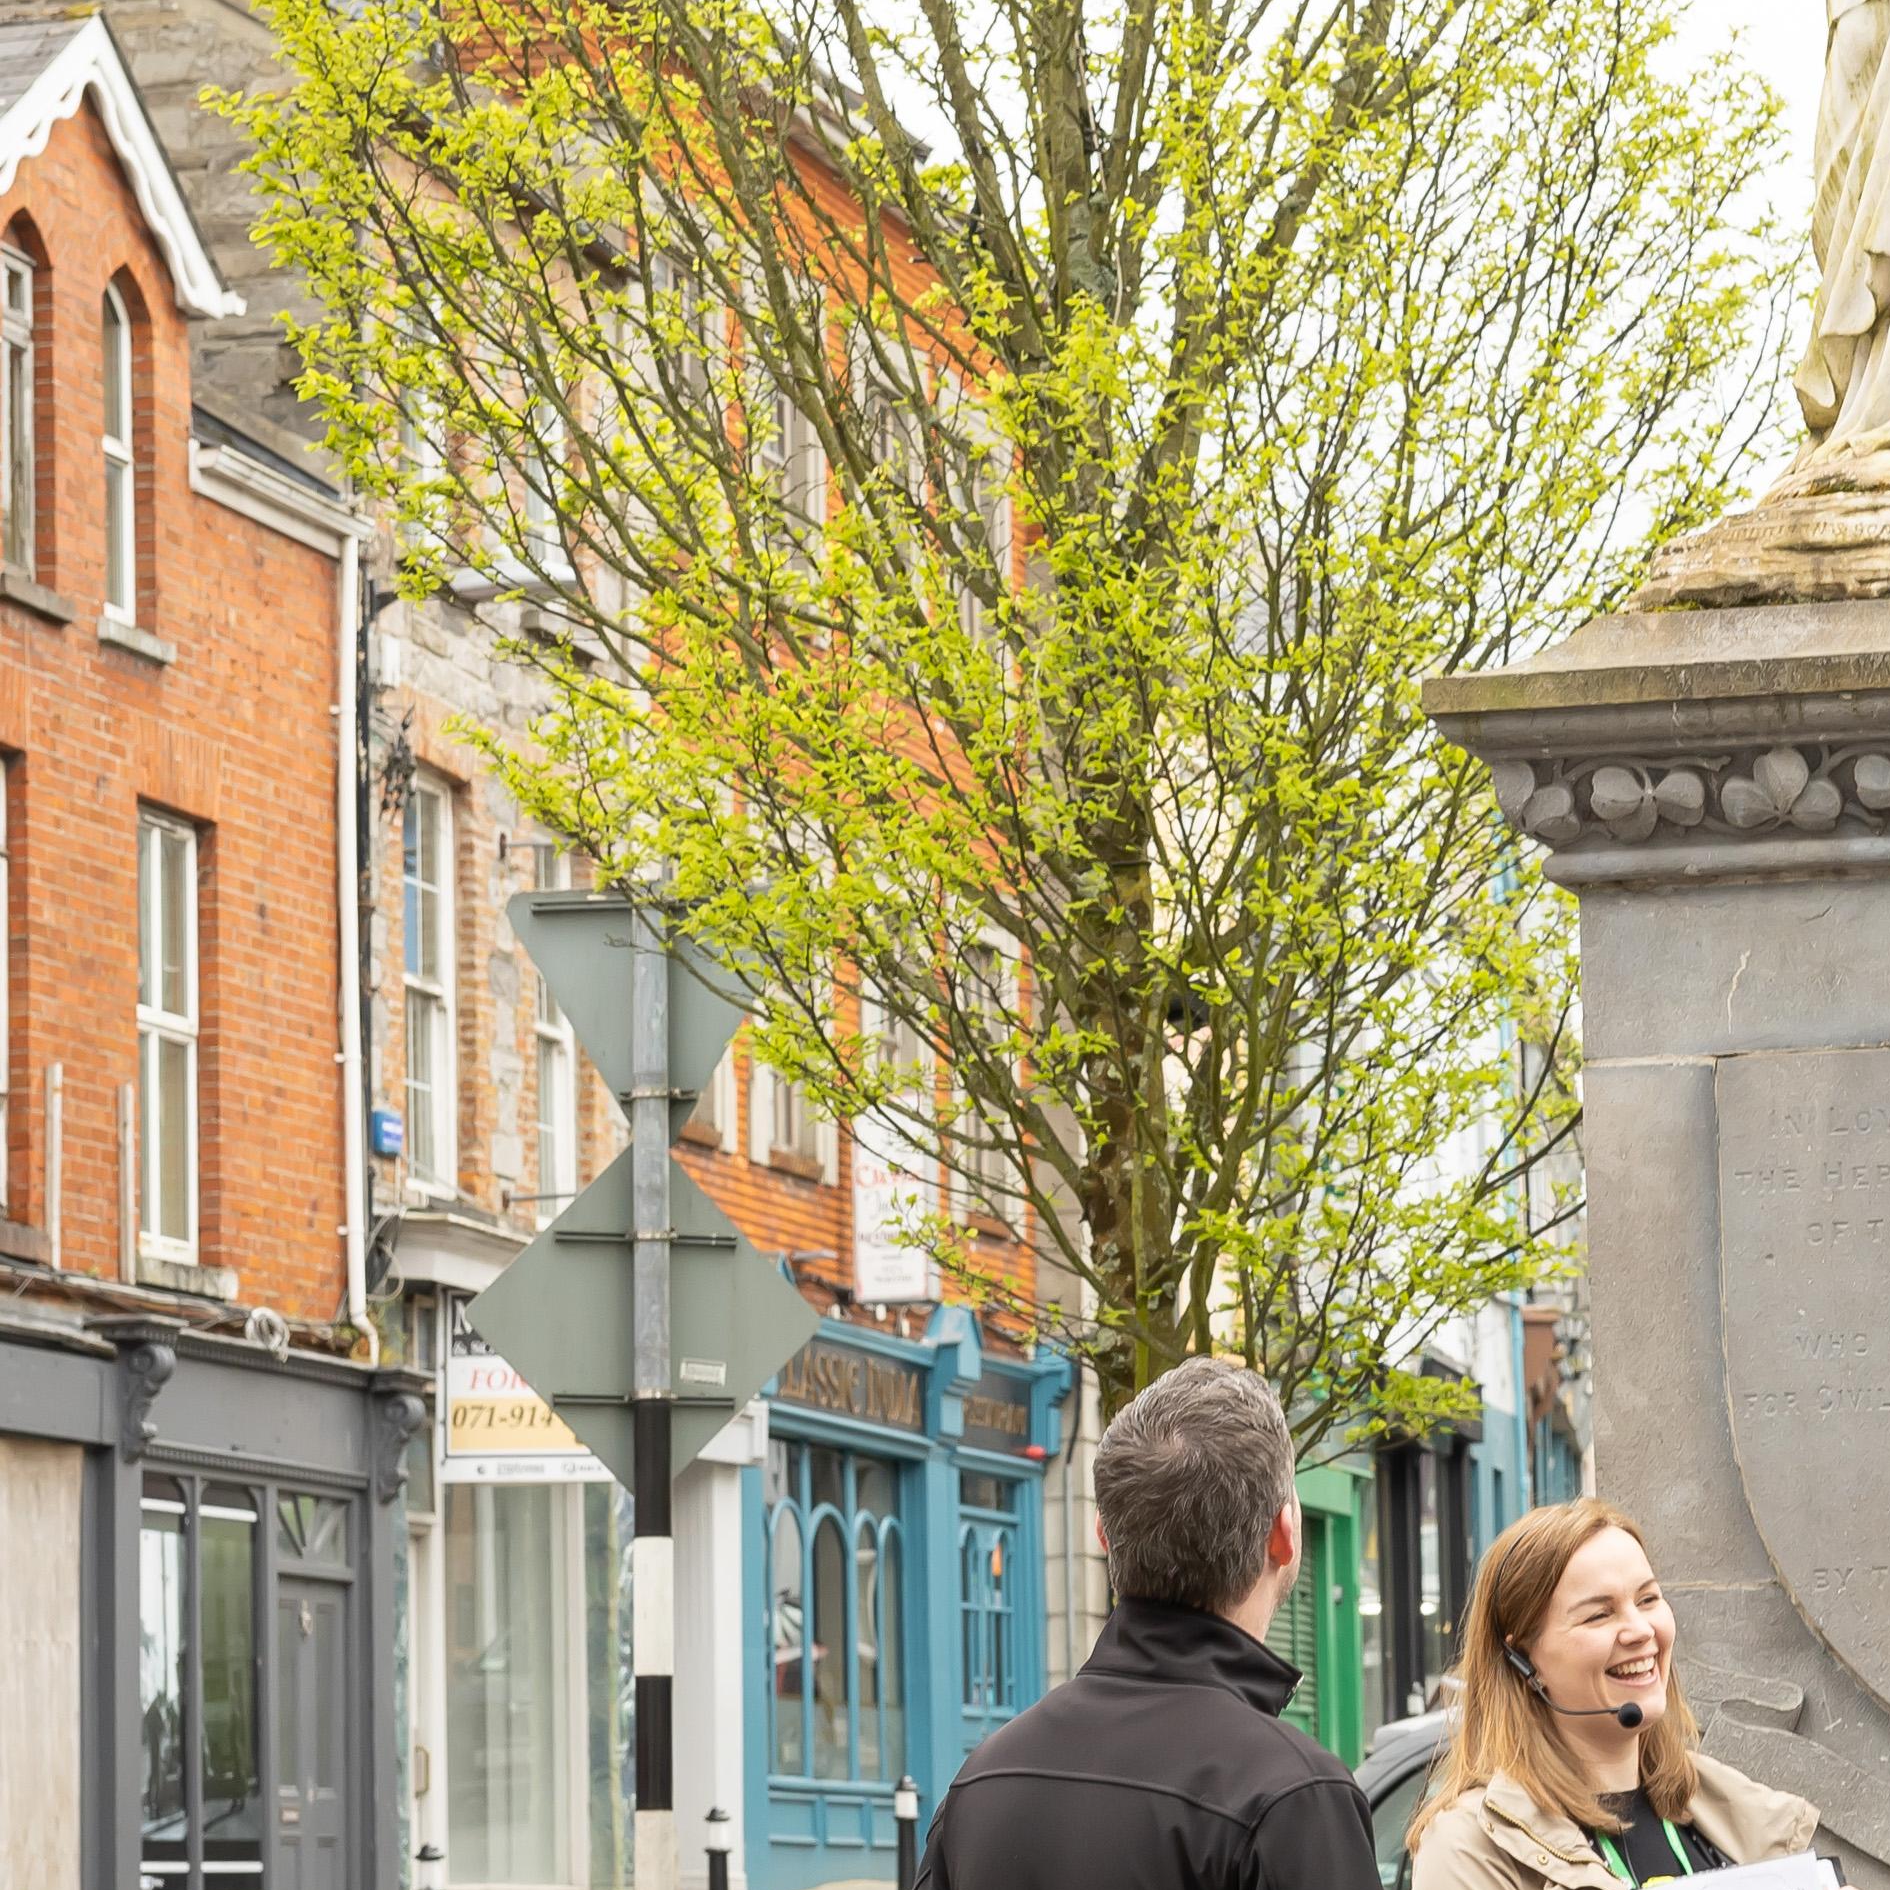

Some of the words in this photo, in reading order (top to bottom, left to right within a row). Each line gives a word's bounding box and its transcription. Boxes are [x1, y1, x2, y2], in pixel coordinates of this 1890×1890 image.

[1734, 1166, 1803, 1197] THE
[1806, 1219, 1851, 1247] OF
[1794, 1331, 1871, 1360] WHO
[779, 1342, 861, 1414] LASSIC
[1741, 1390, 1804, 1421] FOR
[1811, 1567, 1857, 1596] BY
